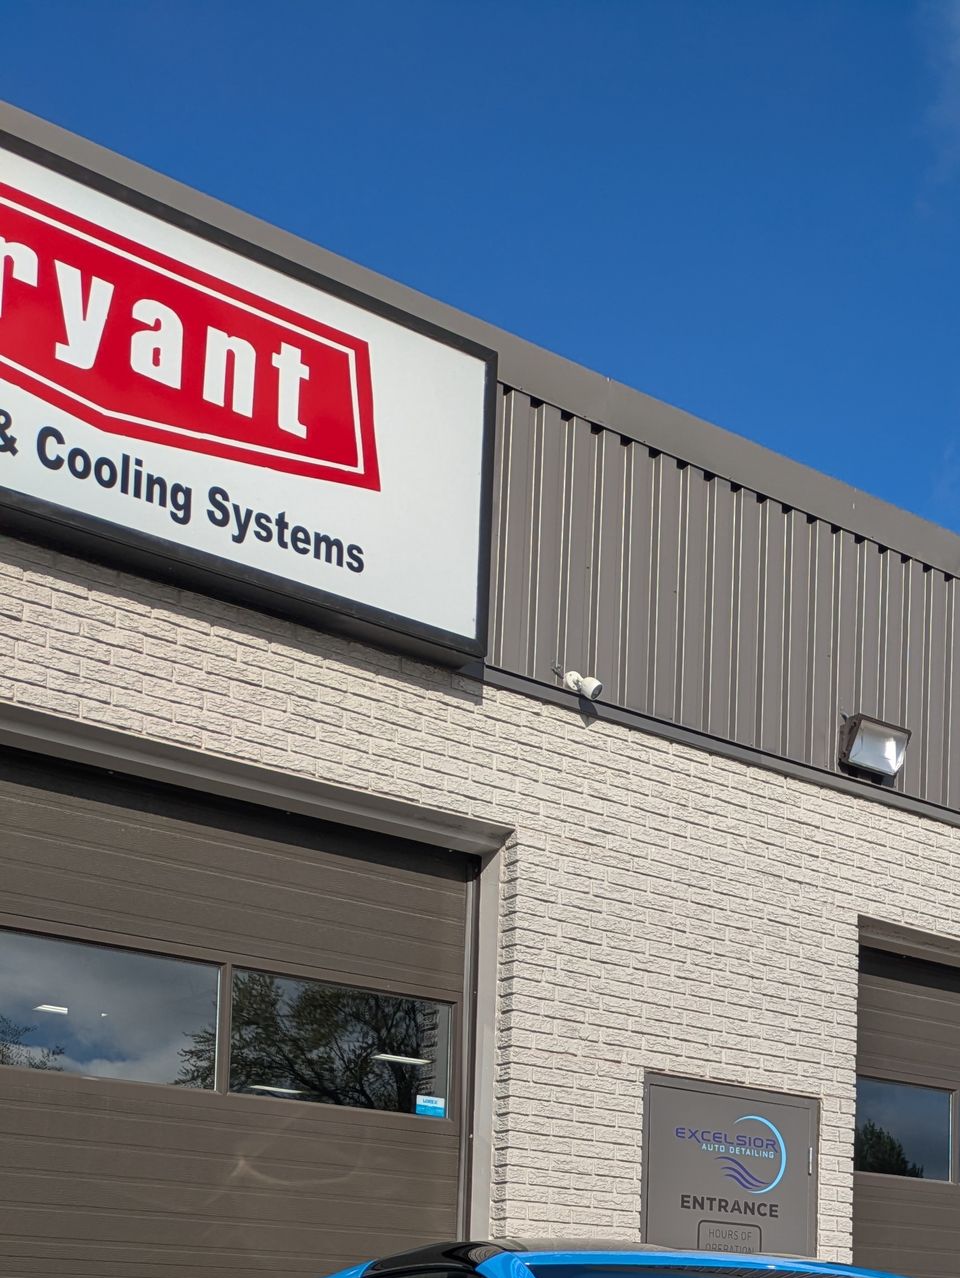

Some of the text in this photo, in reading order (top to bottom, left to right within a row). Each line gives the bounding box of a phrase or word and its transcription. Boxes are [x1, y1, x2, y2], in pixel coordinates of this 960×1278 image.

[36, 426, 193, 526] Cooling
[206, 486, 365, 574] Systems
[675, 1127, 777, 1153] EXCELSIOR
[701, 1143, 775, 1159] AUTO DETAILING
[680, 1194, 779, 1218] ENTRANCE
[708, 1228, 752, 1241] HOURS OF
